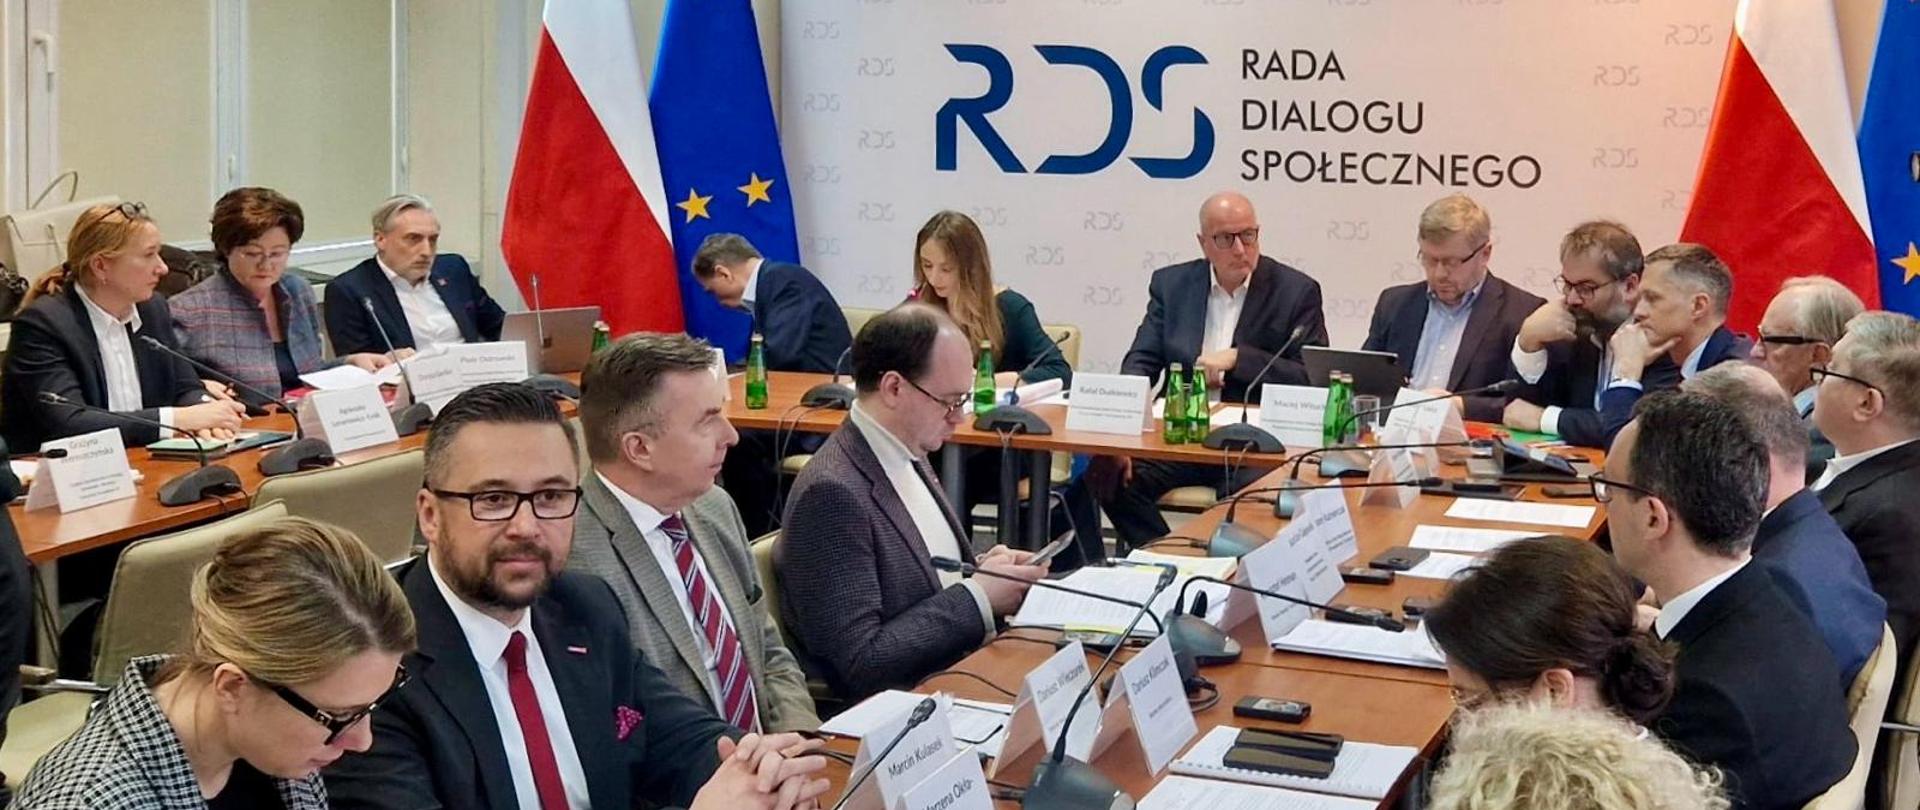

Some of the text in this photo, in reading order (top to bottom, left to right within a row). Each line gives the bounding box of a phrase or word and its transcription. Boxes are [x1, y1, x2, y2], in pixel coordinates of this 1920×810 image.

[802, 22, 841, 40] RDS
[1664, 24, 1714, 46] RDS
[858, 58, 896, 77] RDS
[1240, 48, 1347, 82] RADA
[1593, 65, 1641, 87] RDS
[803, 93, 841, 112] RDS
[936, 42, 1216, 179] RDS
[1240, 98, 1425, 135] DIALOGU
[858, 130, 896, 149] RDS
[1592, 147, 1640, 169] RDS
[803, 166, 841, 184] RDS
[1239, 148, 1543, 190] SPOŁECZNEGO
[858, 203, 896, 222] RDS
[1083, 211, 1125, 231] RDS
[1326, 220, 1370, 241] RDS
[1025, 246, 1065, 266] RDS
[1083, 286, 1123, 305] RDS
[887, 736, 943, 779] Marcin Kulasek
[922, 791, 955, 810] arzena
